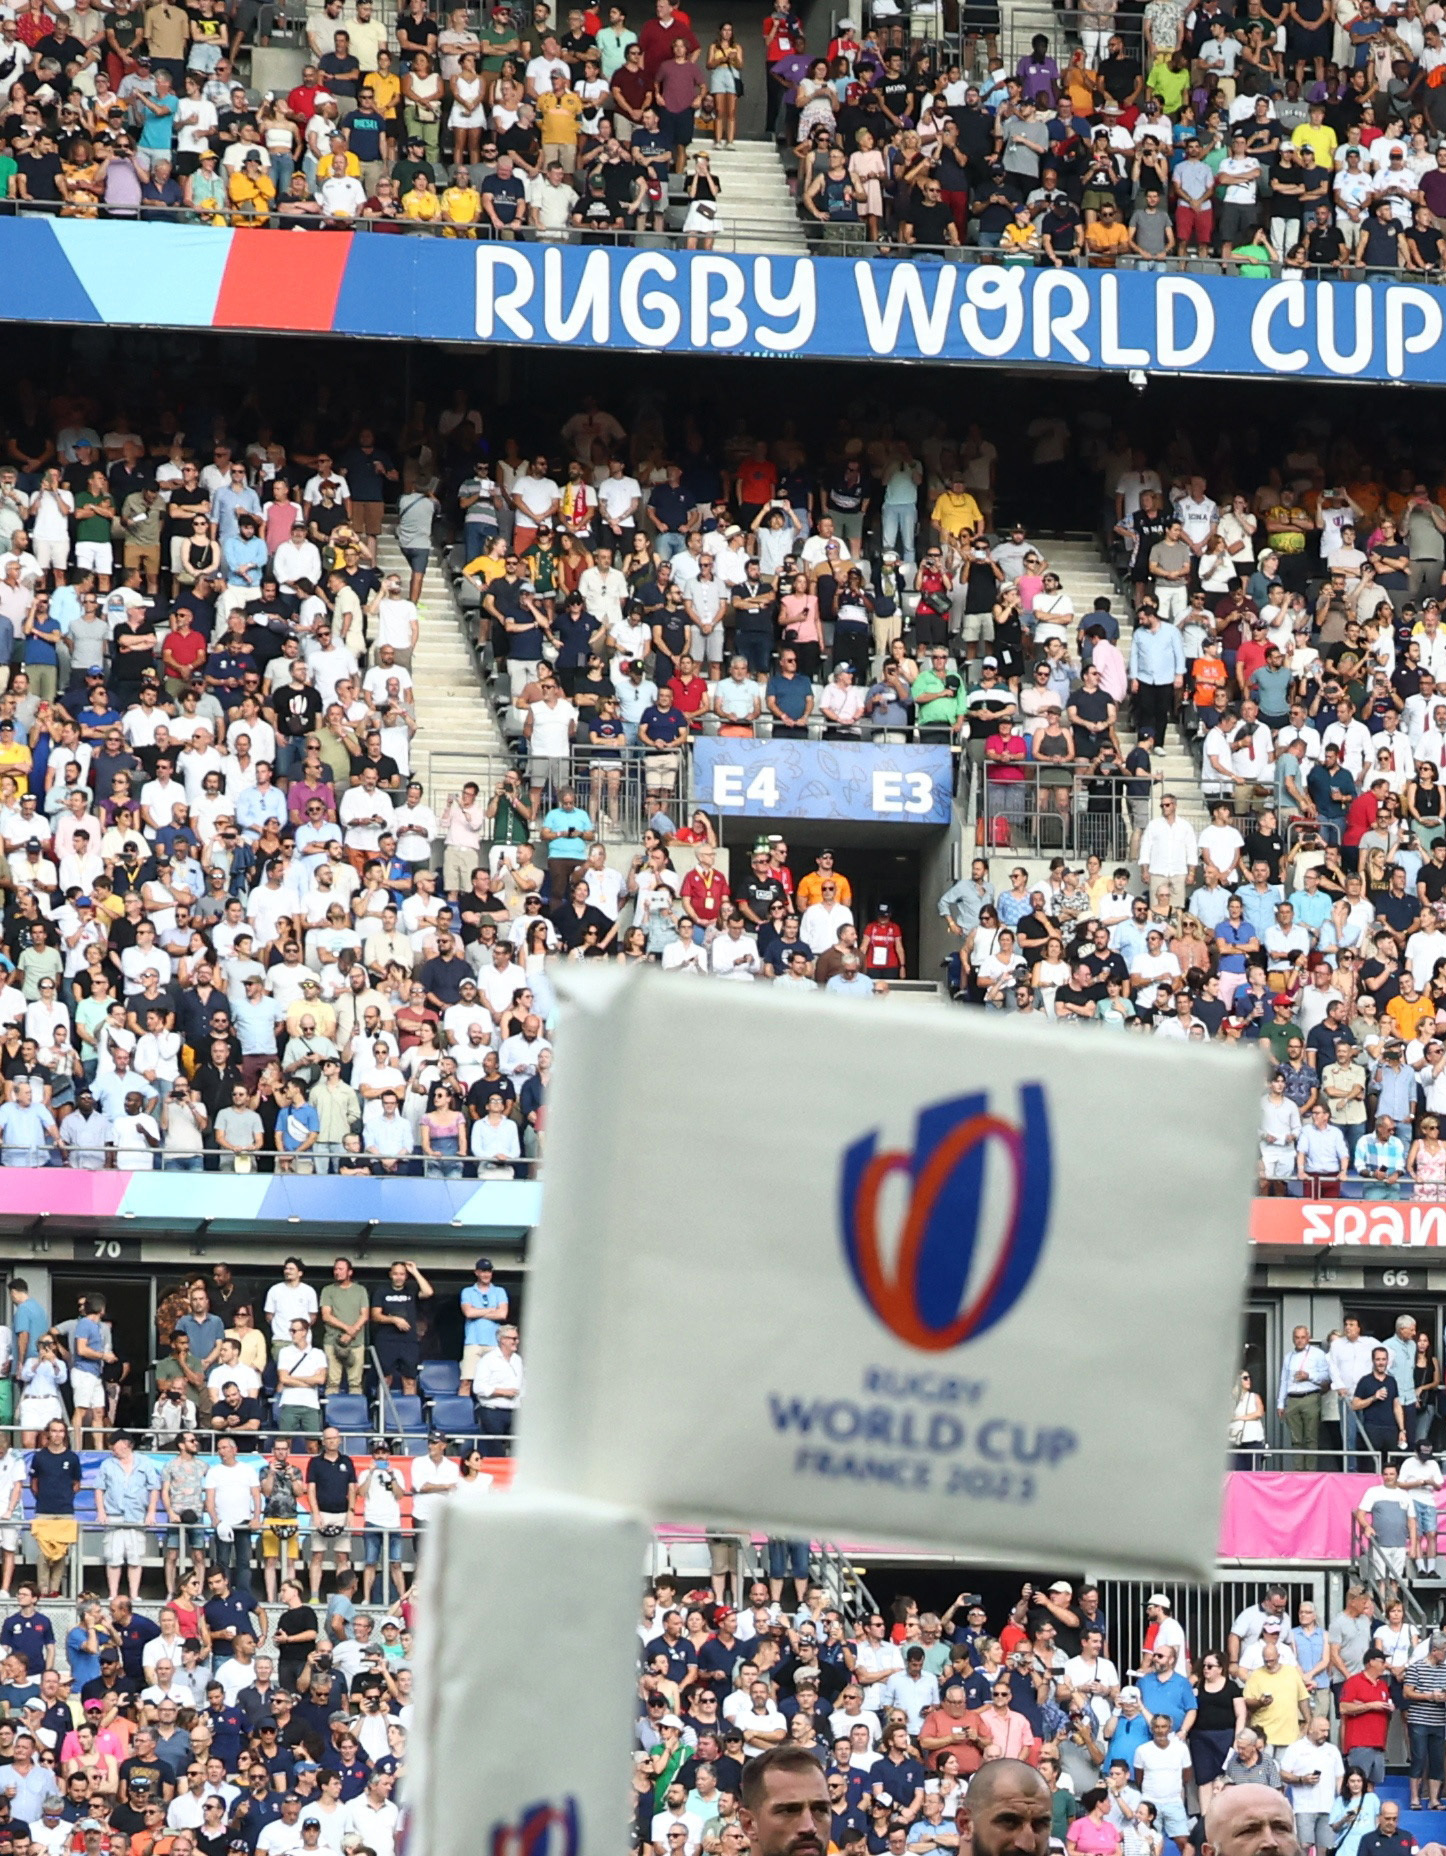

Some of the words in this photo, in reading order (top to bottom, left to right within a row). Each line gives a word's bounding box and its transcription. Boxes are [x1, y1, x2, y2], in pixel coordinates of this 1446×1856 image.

[475, 245, 816, 351] RUGBY
[855, 258, 1215, 369] WORLD
[1251, 280, 1444, 378] CUP
[712, 765, 780, 808] E4
[872, 770, 934, 813] E3
[93, 1240, 121, 1258] 70
[1382, 1270, 1410, 1287] 66
[767, 1393, 966, 1455] WORLD
[976, 1419, 1081, 1469] CUP
[795, 1447, 931, 1492] FRANCE
